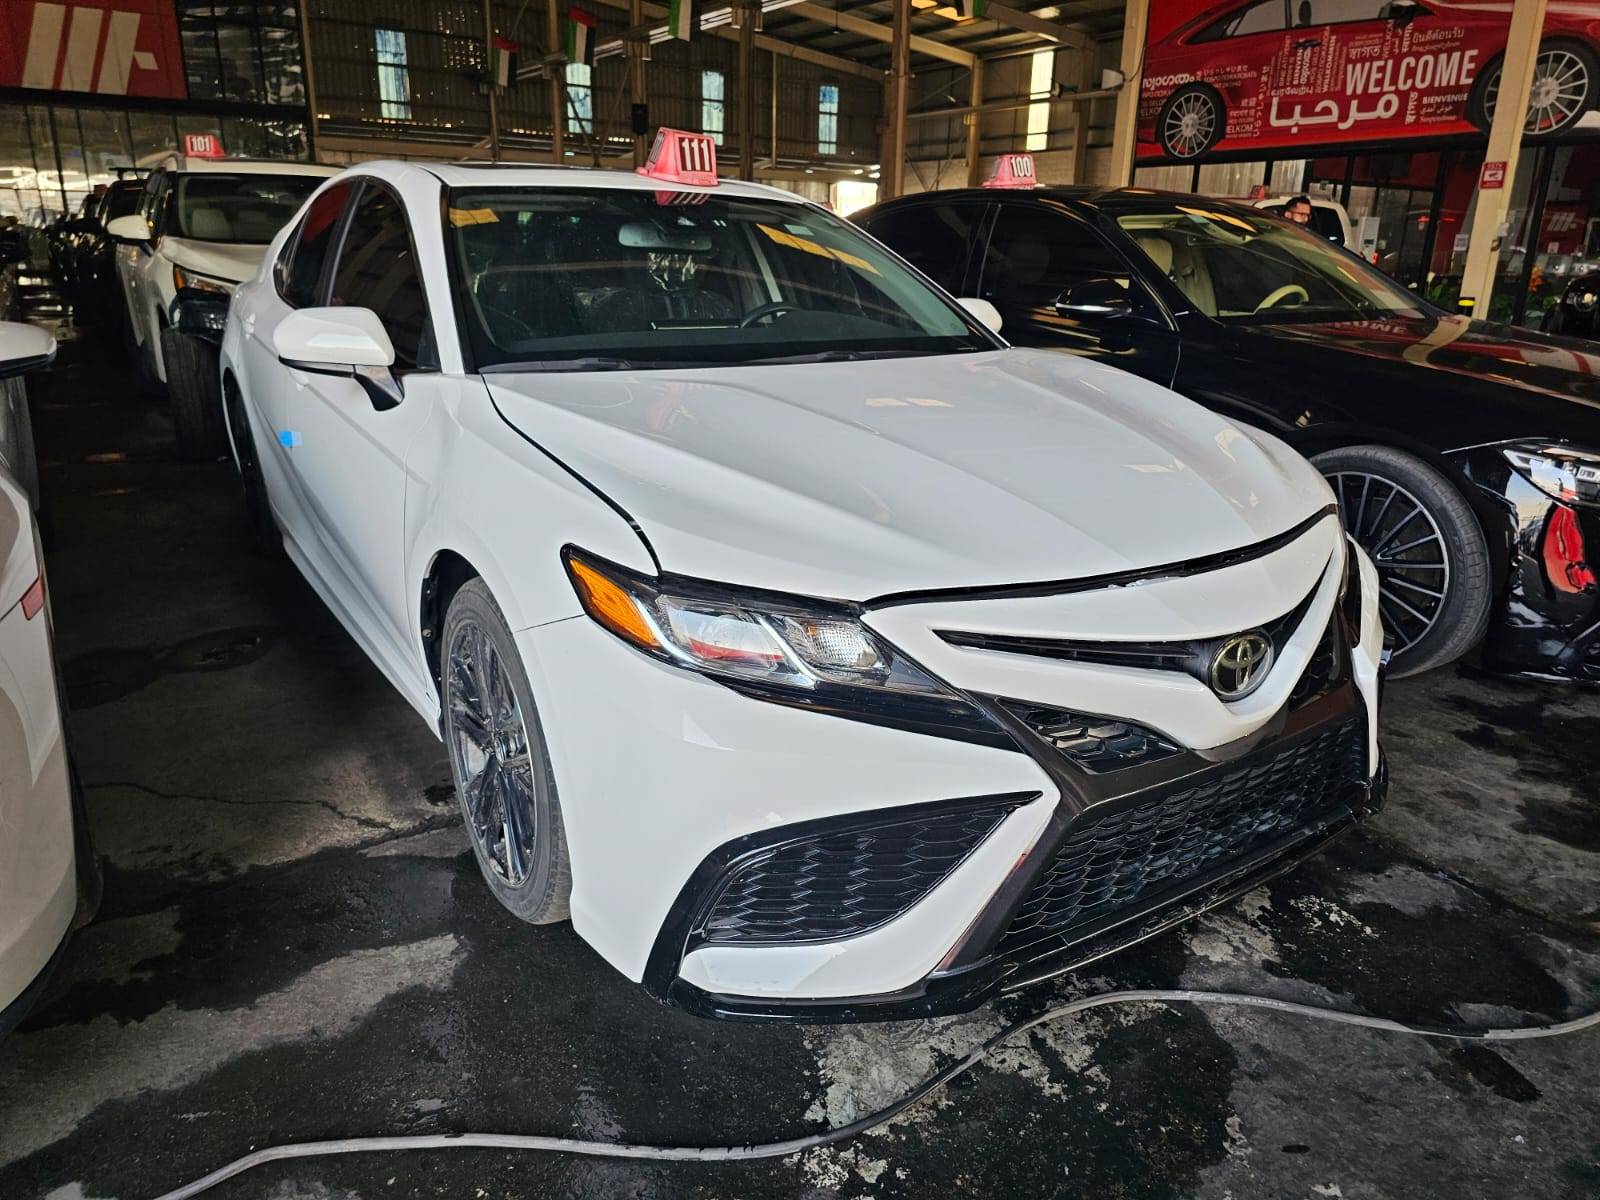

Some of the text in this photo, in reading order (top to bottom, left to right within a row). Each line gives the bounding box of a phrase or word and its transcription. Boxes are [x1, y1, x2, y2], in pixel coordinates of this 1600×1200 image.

[1346, 49, 1479, 95] WELCOME
[1270, 93, 1399, 134] مرحبا
[1225, 123, 1254, 134] ELKOM
[192, 136, 210, 152] 101
[682, 138, 710, 171] 111
[1011, 157, 1031, 177] 100
